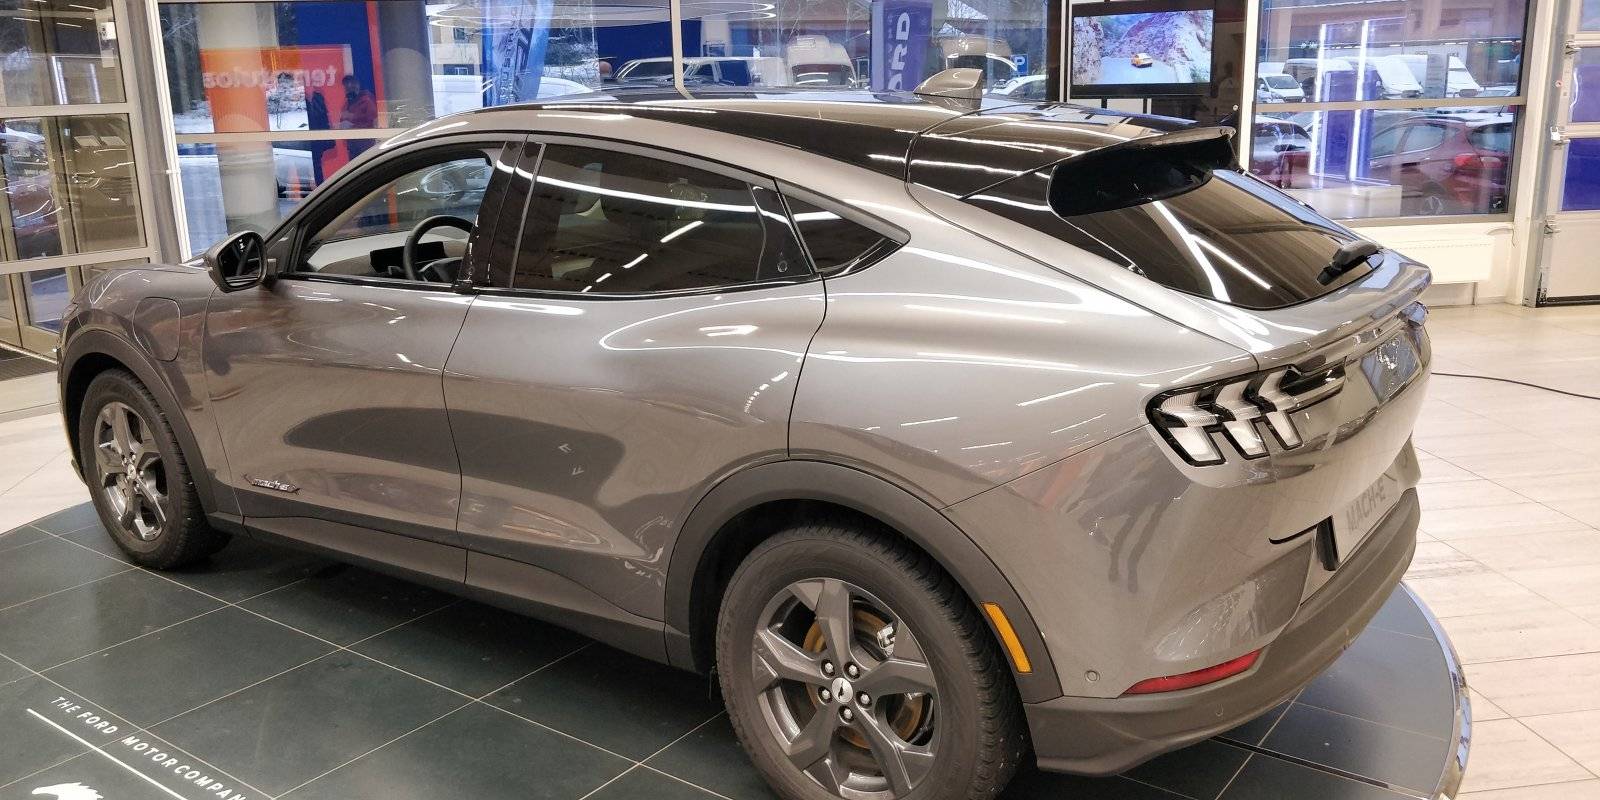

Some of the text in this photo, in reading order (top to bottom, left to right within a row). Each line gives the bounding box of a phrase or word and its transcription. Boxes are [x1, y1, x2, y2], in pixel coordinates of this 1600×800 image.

[1346, 476, 1386, 534] MACH-E
[51, 696, 81, 713] THE
[77, 711, 118, 734] FORD
[121, 735, 179, 768] MOTOR
